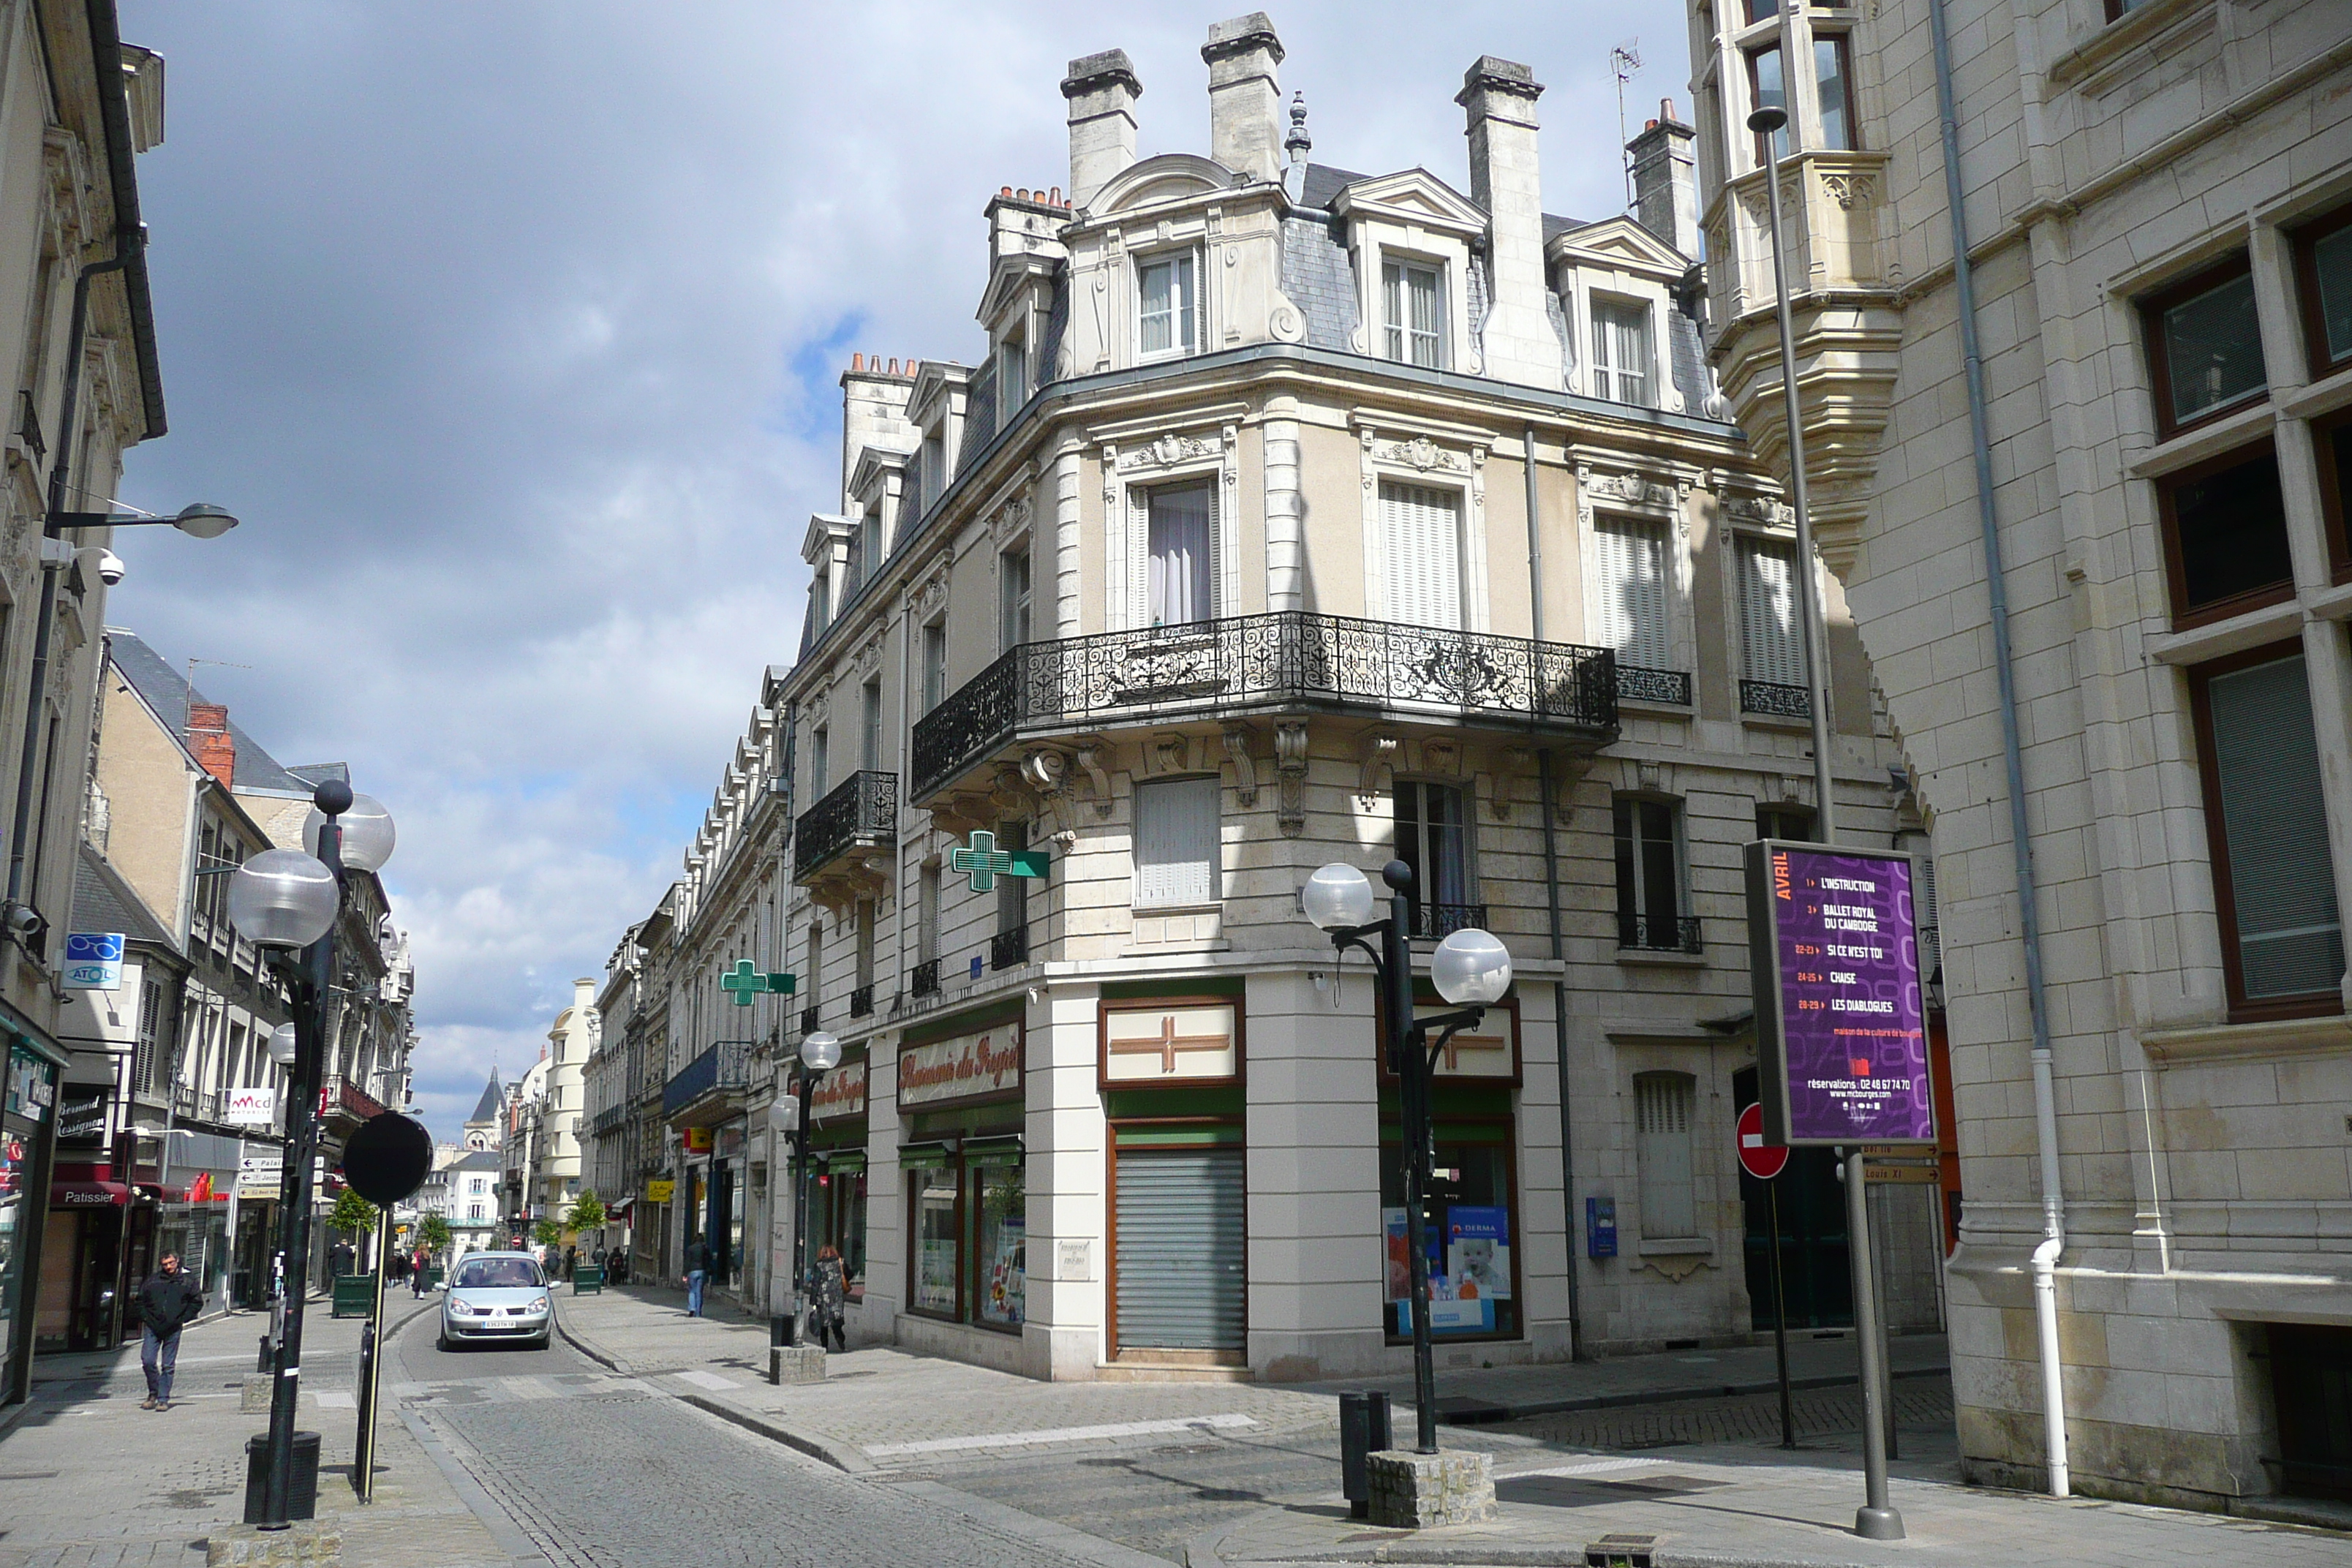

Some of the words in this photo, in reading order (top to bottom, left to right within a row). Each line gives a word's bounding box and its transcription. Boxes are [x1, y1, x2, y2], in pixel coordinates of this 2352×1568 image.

[1773, 852, 1791, 900] AVRIL
[1821, 877, 1875, 892] L'INSTRUCTION
[1807, 905, 1812, 914] 3
[1823, 904, 1851, 917] BALLET
[1852, 906, 1876, 919] ROYAL
[1824, 918, 1837, 929] DU
[1838, 919, 1878, 932] CAMBODGE
[1795, 944, 1814, 954] 22-23
[1827, 944, 1836, 956] SI
[1837, 945, 1847, 957] CE
[1848, 946, 1869, 958] N'EST
[1869, 947, 1882, 959] TOI
[74, 968, 110, 981] ATOL
[1798, 972, 1816, 981] 24-25
[1830, 971, 1857, 984] CHAISE
[1832, 999, 1845, 1011] LES
[1847, 1000, 1893, 1012] DIABLOGUES
[1833, 1028, 1856, 1036] maison
[1856, 1028, 1863, 1036] de
[1864, 1028, 1871, 1036] la
[1871, 1028, 1891, 1037] culture
[1808, 1079, 1856, 1090] réservations
[1861, 1079, 1871, 1089] 02
[1872, 1079, 1881, 1090] 48
[1882, 1079, 1891, 1090] 67
[1892, 1080, 1901, 1090] 74
[1901, 1080, 1910, 1090] 70
[1830, 1090, 1891, 1099] www.mcbourges.com
[59, 1096, 99, 1116] Bernard
[1866, 1169, 1888, 1178] Louis
[1893, 1169, 1901, 1178] XI
[65, 1191, 115, 1203] Patissier
